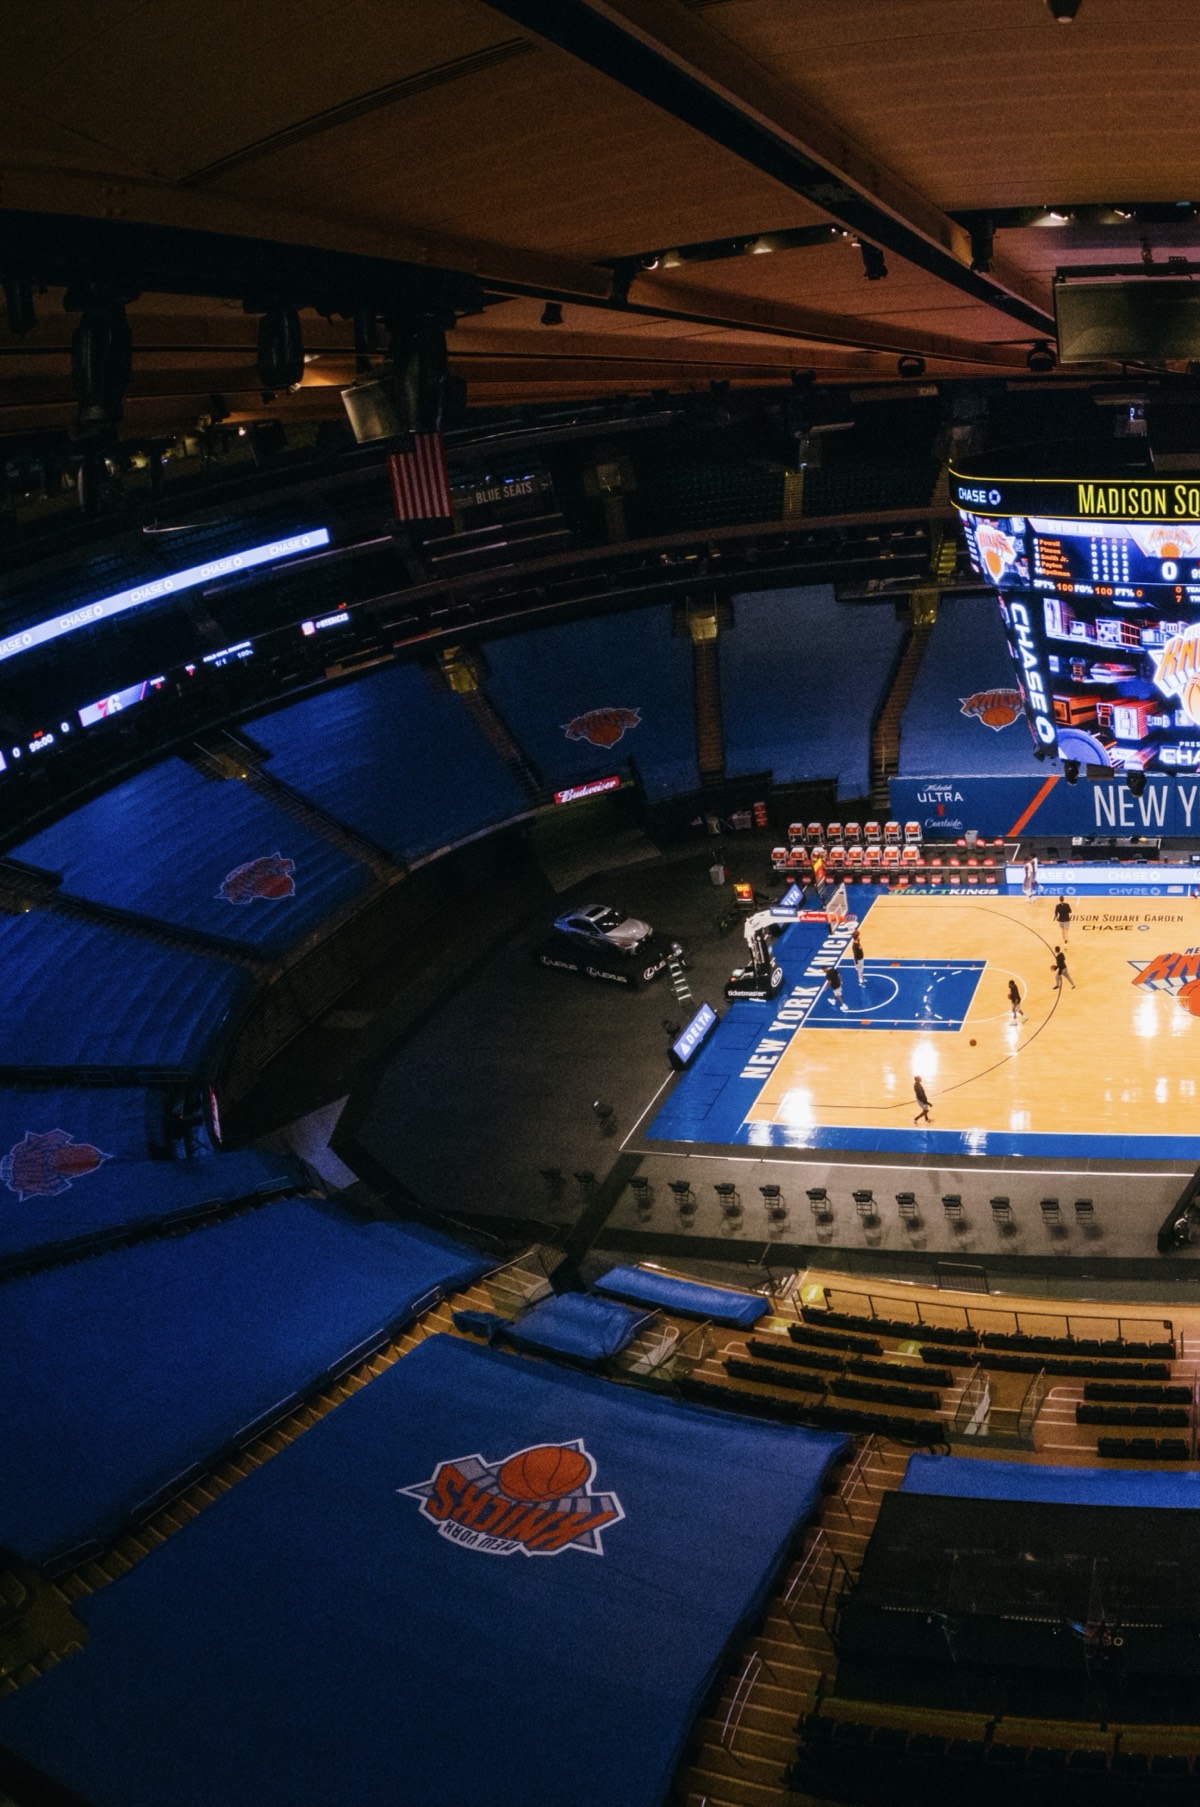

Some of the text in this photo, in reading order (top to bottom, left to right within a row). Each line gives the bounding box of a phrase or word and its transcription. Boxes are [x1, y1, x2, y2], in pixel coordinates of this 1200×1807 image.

[475, 488, 501, 504] BLUE
[503, 482, 533, 498] SEATS
[958, 488, 987, 504] CHASE
[1078, 484, 1167, 515] MADISON
[269, 538, 302, 555] CHASE
[201, 560, 234, 578] CHASE
[1162, 561, 1177, 580] 0
[130, 583, 165, 602] CHASE
[1057, 583, 1073, 592] 100
[1074, 585, 1094, 594] FG%
[1095, 587, 1113, 595] 100
[1136, 589, 1143, 597] 0
[1175, 586, 1182, 594] 0
[1175, 595, 1182, 603] 7
[60, 609, 94, 630] CHASE
[0, 638, 23, 656] ASE
[1010, 602, 1048, 714] CHASE
[29, 733, 54, 753] 99:00
[557, 780, 616, 803] Budweiser
[917, 792, 964, 803] ULTRA
[1093, 785, 1168, 827] NEW
[1107, 871, 1149, 881] CHASE
[1053, 914, 1184, 923] DISON SQUARE GARDEN
[740, 921, 859, 1079] NEW YORK KNICKS
[686, 1010, 712, 1044] DELTA
[426, 1463, 616, 1550] KNICKS
[443, 1520, 518, 1551] NEW YORK
